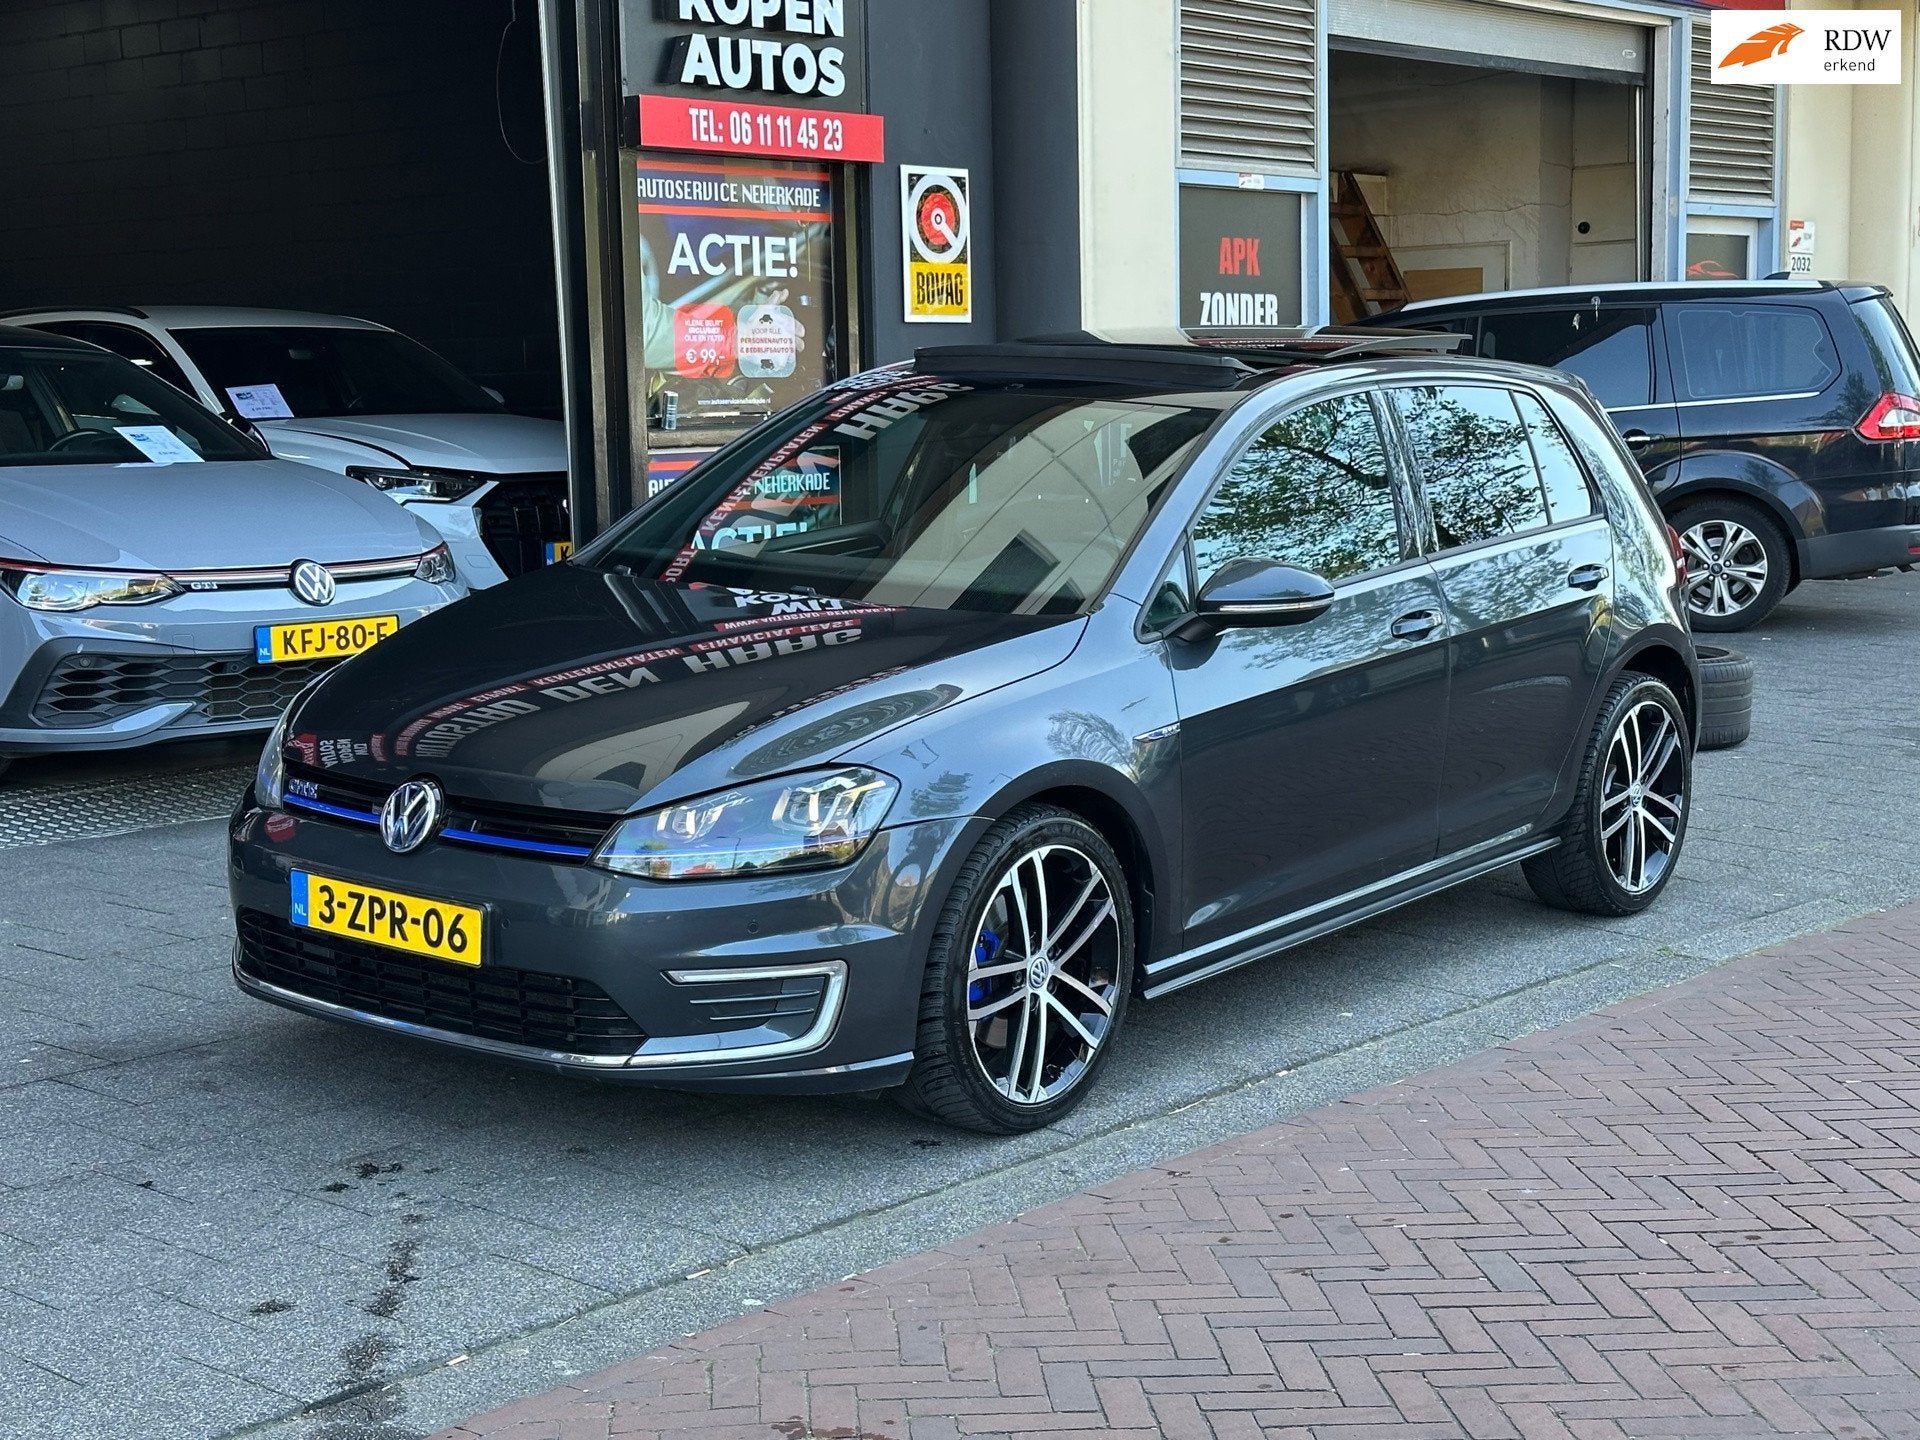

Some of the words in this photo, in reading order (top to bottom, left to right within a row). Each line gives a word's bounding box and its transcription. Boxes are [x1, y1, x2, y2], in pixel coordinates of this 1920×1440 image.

[681, 33, 846, 97] AUTOS
[689, 108, 724, 143] TEL:
[730, 111, 751, 145] 06
[757, 113, 772, 146] 11
[777, 115, 792, 148] 11
[797, 117, 818, 150] 45
[823, 118, 843, 151] 23
[637, 178, 738, 202] AUTOSERVICE
[742, 184, 821, 207] NEHERKADE
[668, 232, 798, 278] ACTIE!
[1219, 237, 1261, 277] APK
[1791, 256, 1811, 271] 2032
[916, 271, 954, 306] BOVAG
[1200, 292, 1278, 326] ZONDER
[754, 472, 831, 495] NEHERKADE
[260, 648, 271, 656] NL
[294, 902, 307, 917] NL
[318, 884, 468, 953] 3-ZPR-06
